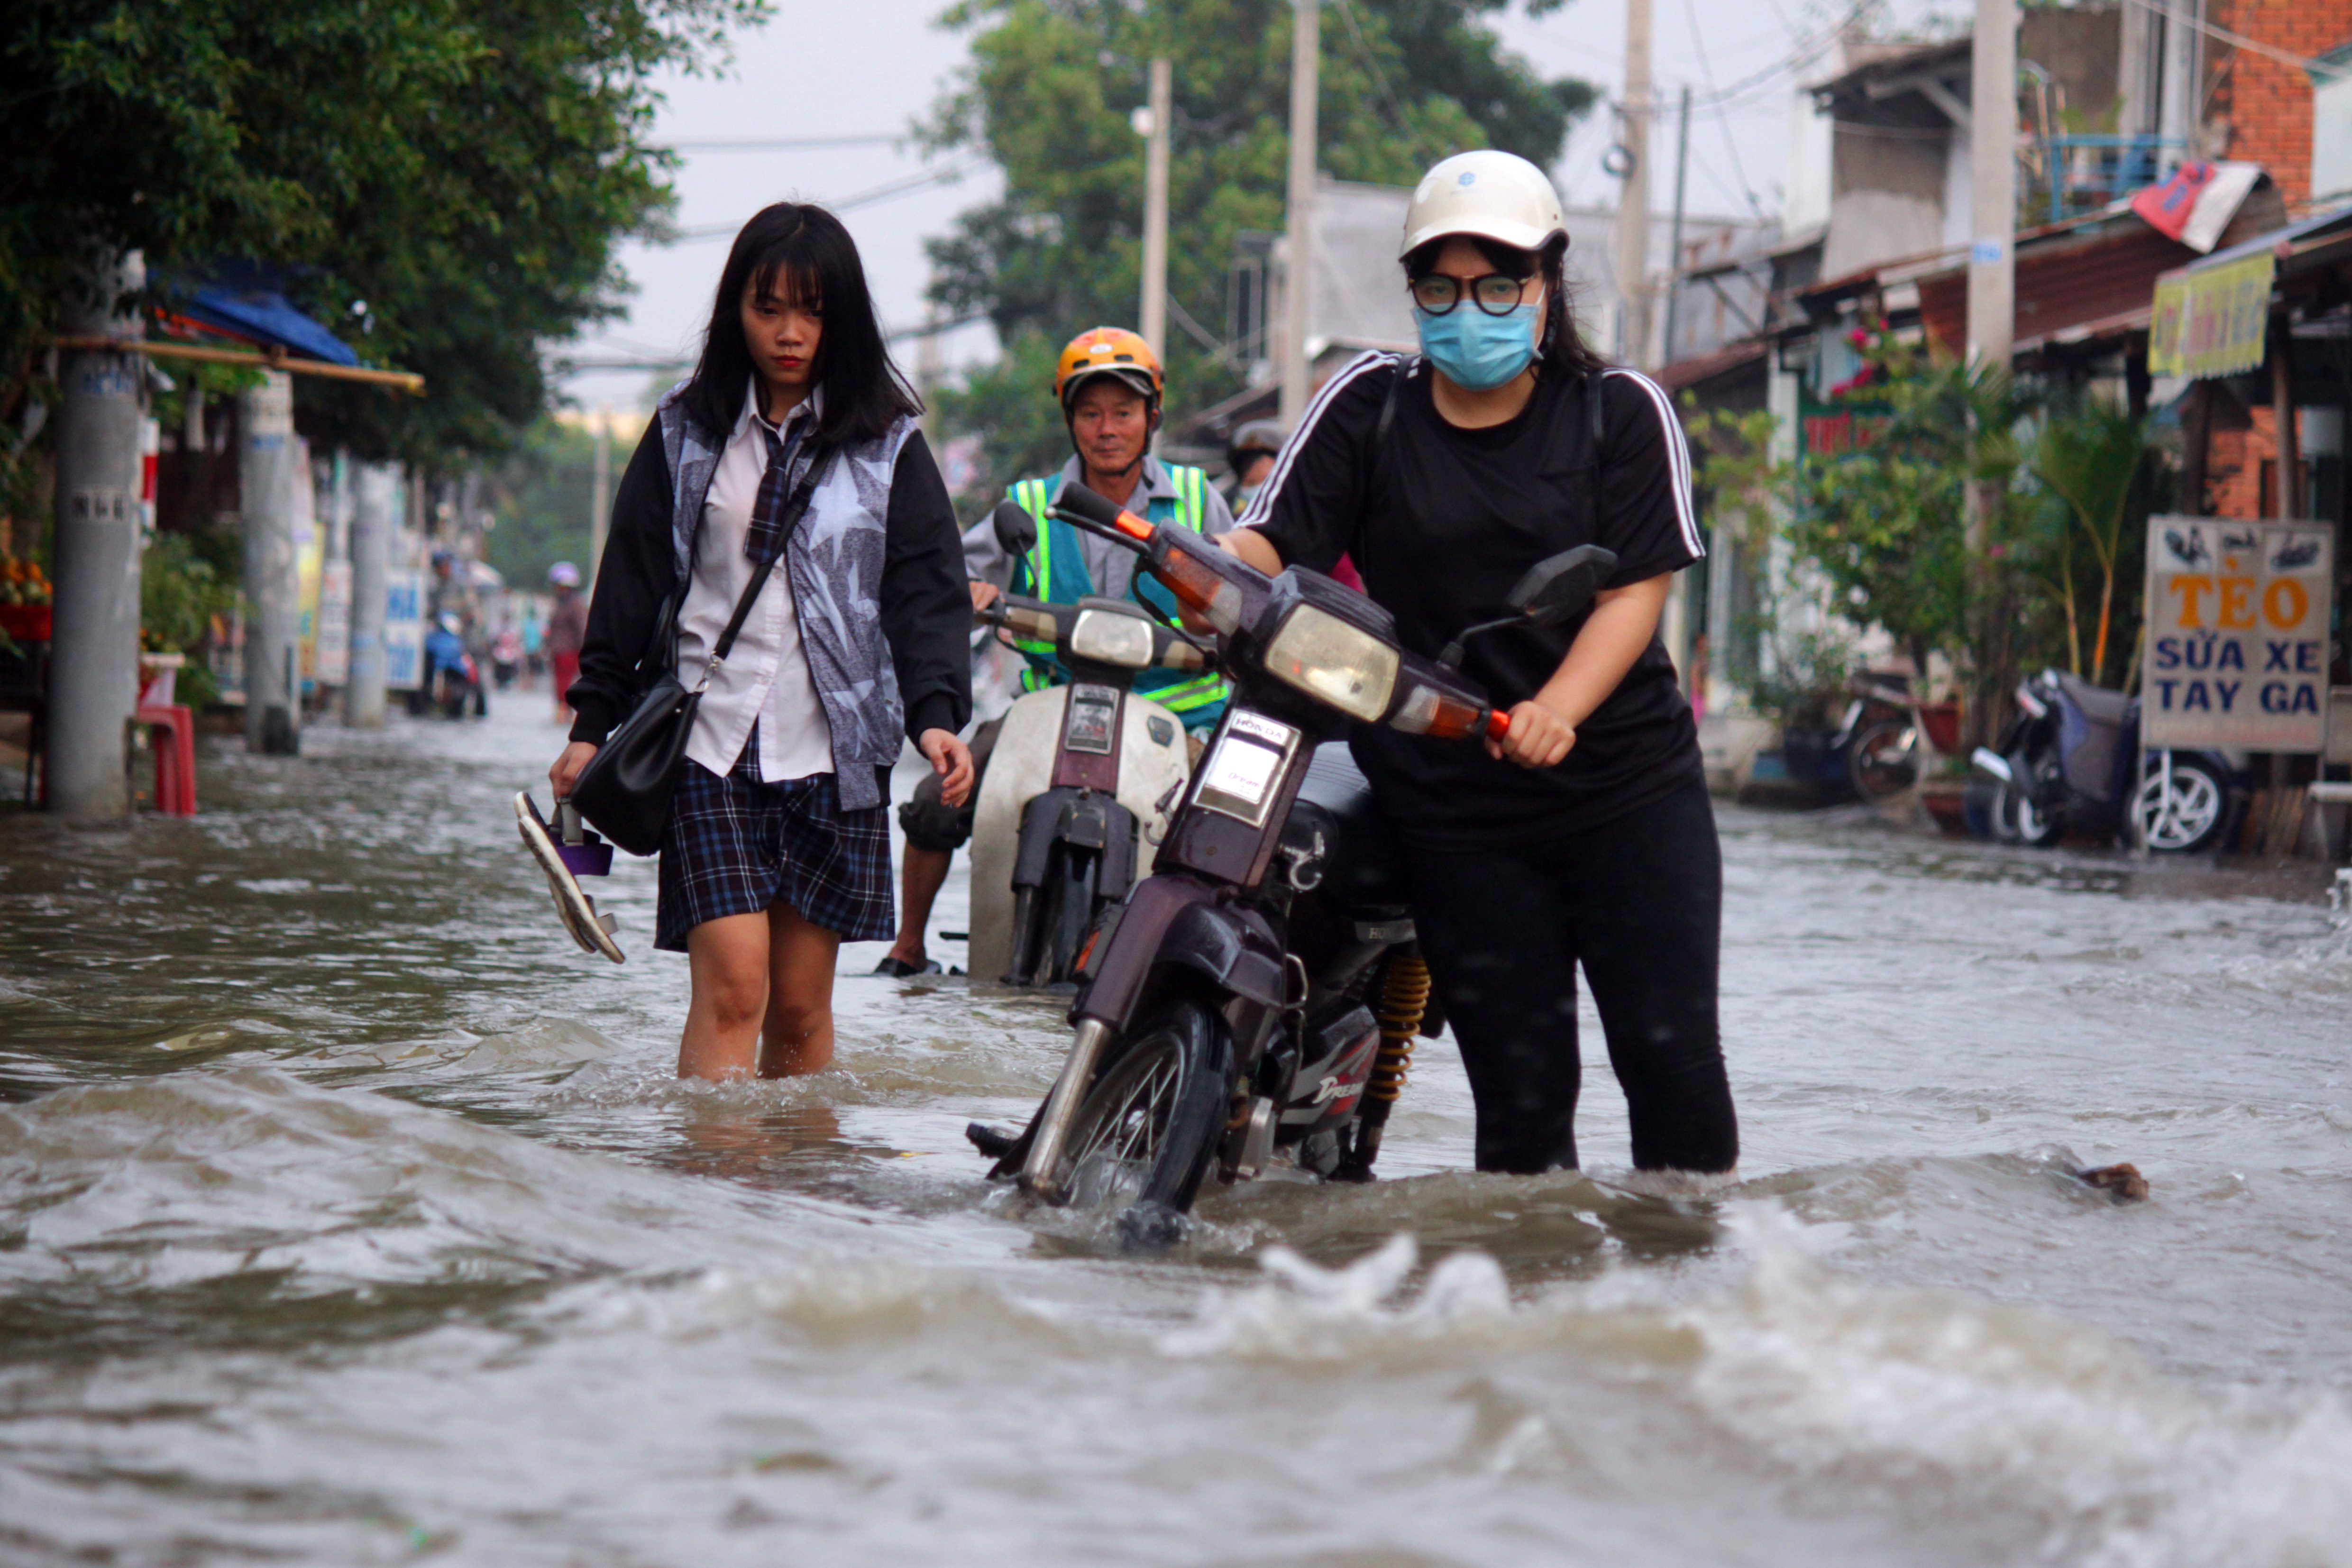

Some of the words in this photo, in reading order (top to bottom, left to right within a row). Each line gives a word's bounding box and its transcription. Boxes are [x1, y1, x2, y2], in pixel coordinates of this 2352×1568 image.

[2156, 627, 2244, 671] SỬA
[2264, 640, 2322, 673] XE
[2155, 679, 2242, 712] TAY
[2260, 681, 2320, 715] GA
[1235, 718, 1282, 739] HONDA
[1228, 772, 1260, 788] Dream
